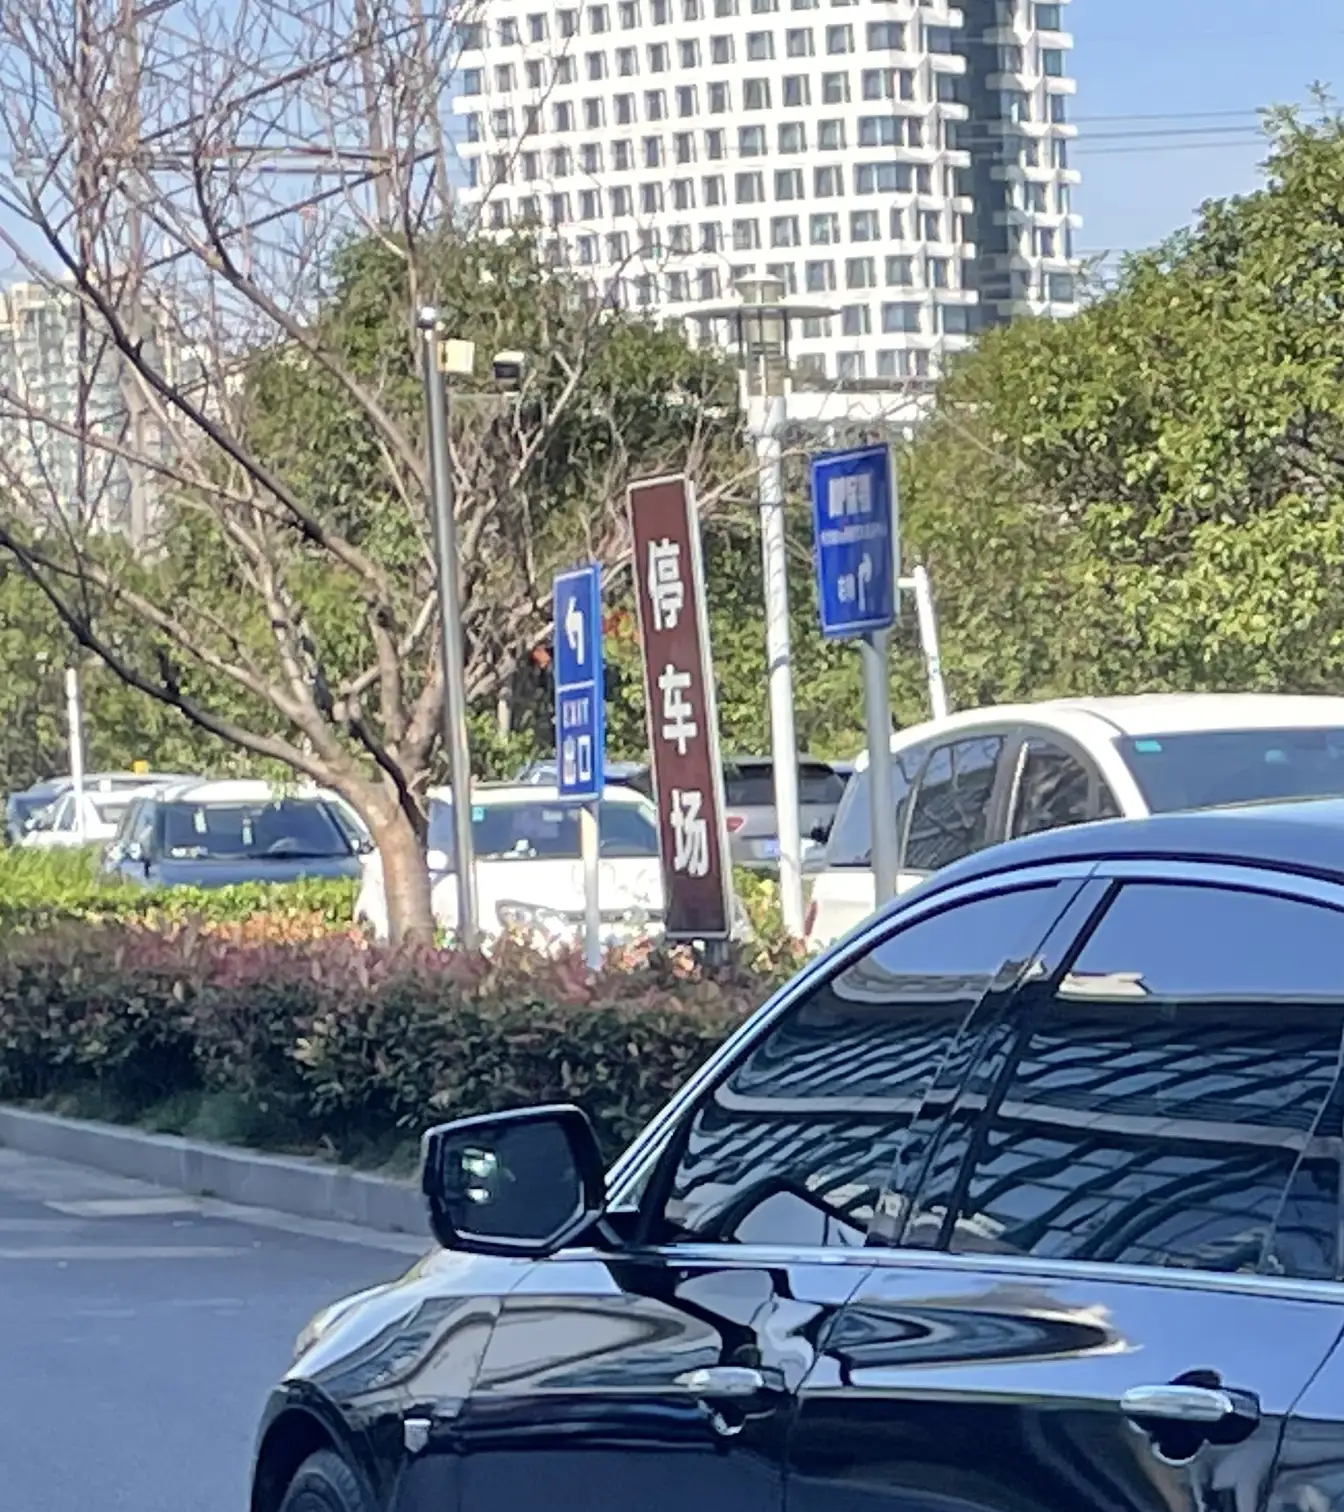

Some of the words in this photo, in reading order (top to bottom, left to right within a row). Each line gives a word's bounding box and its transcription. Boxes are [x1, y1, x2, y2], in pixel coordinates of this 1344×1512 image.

[562, 734, 592, 786] 出口
[647, 537, 710, 878] 停车场
